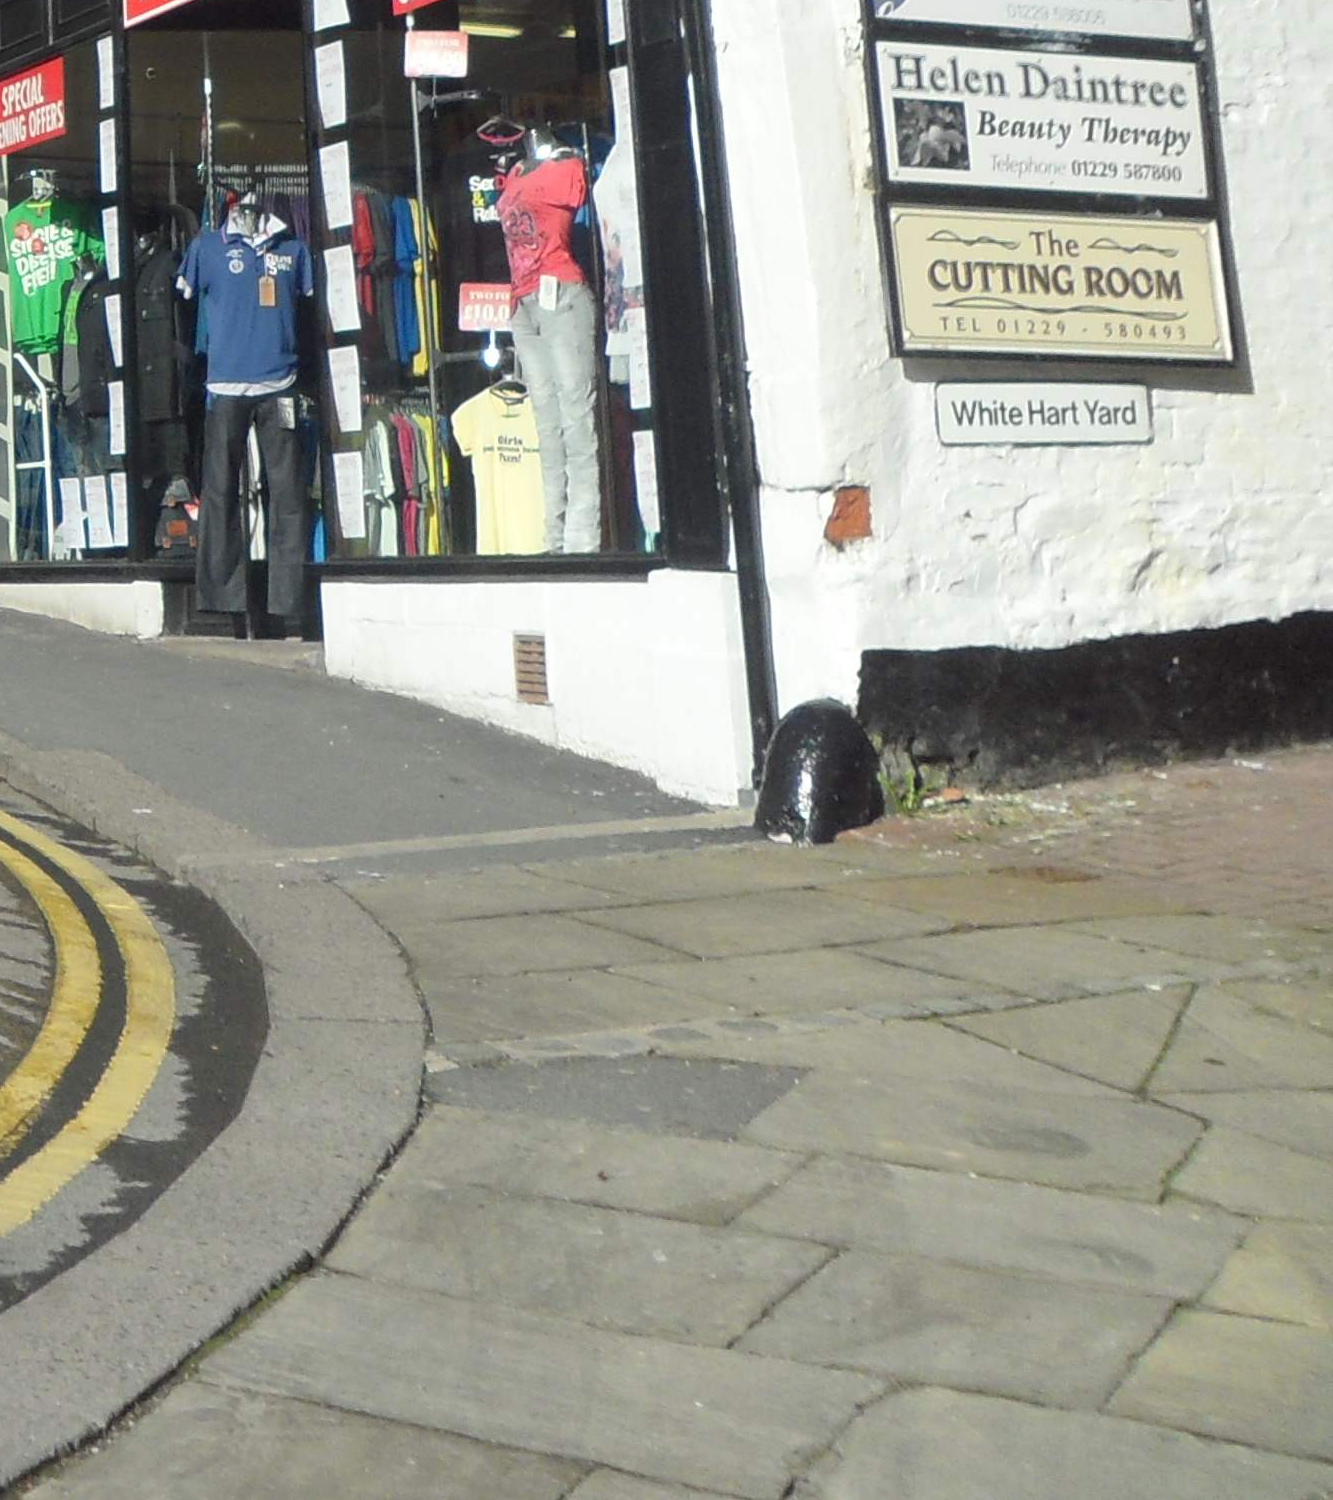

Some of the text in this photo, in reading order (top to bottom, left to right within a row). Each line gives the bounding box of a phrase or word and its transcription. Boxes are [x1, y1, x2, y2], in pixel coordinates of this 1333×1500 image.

[1, 72, 45, 117] SPECIAL
[889, 53, 1188, 108] Helen Daintree
[28, 99, 64, 138] OFFERS
[976, 109, 1191, 157] Beauty Therapy
[990, 154, 1068, 177] Telephone
[1071, 161, 1118, 178] 01229
[1029, 229, 1080, 258] The
[927, 259, 1184, 301] CUTTING ROOM
[939, 316, 982, 333] TEL
[996, 318, 1067, 336] 01229
[951, 399, 1137, 427] White Hart Yard
